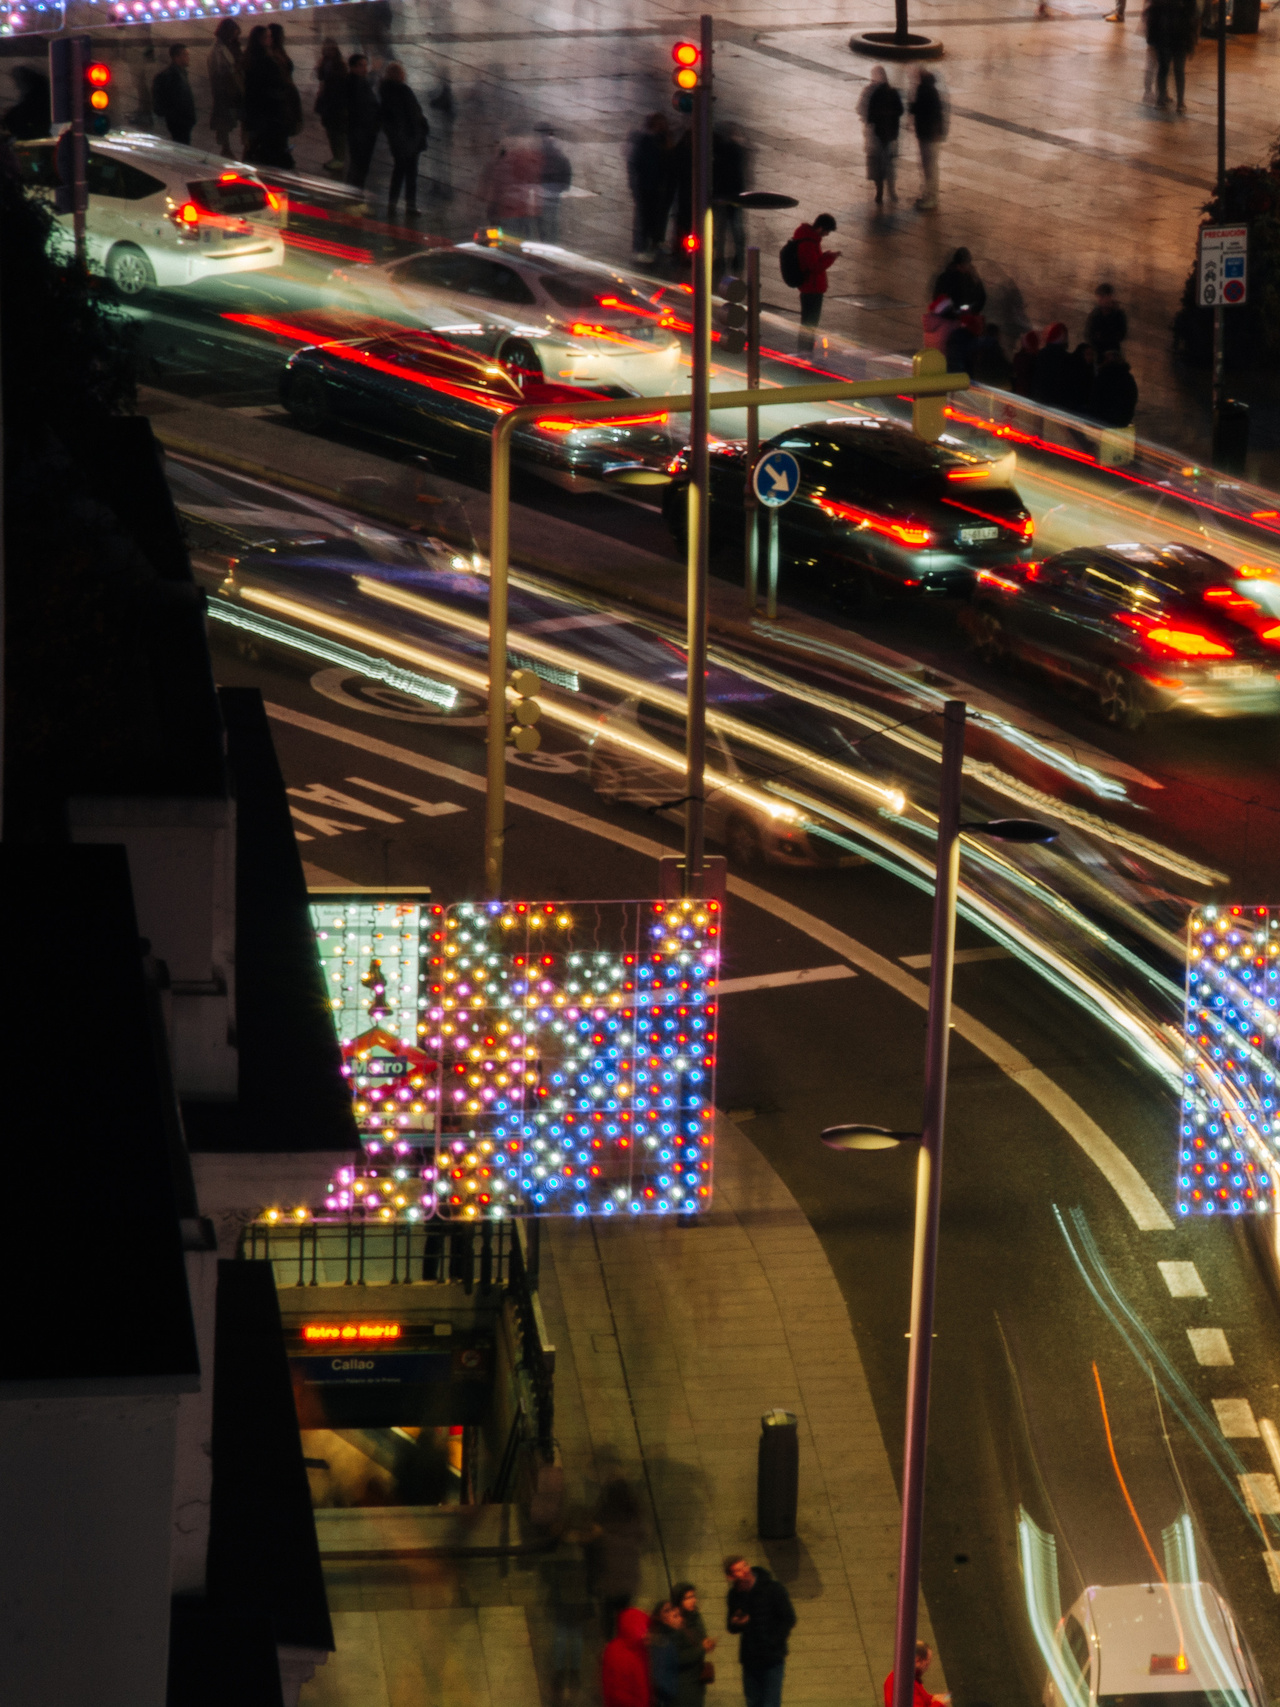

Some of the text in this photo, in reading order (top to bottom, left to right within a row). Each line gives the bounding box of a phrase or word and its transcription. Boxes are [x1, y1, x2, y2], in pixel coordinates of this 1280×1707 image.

[285, 776, 468, 842] TAX
[306, 1325, 399, 1338] Metro de Madrid
[331, 1359, 375, 1371] Callao
